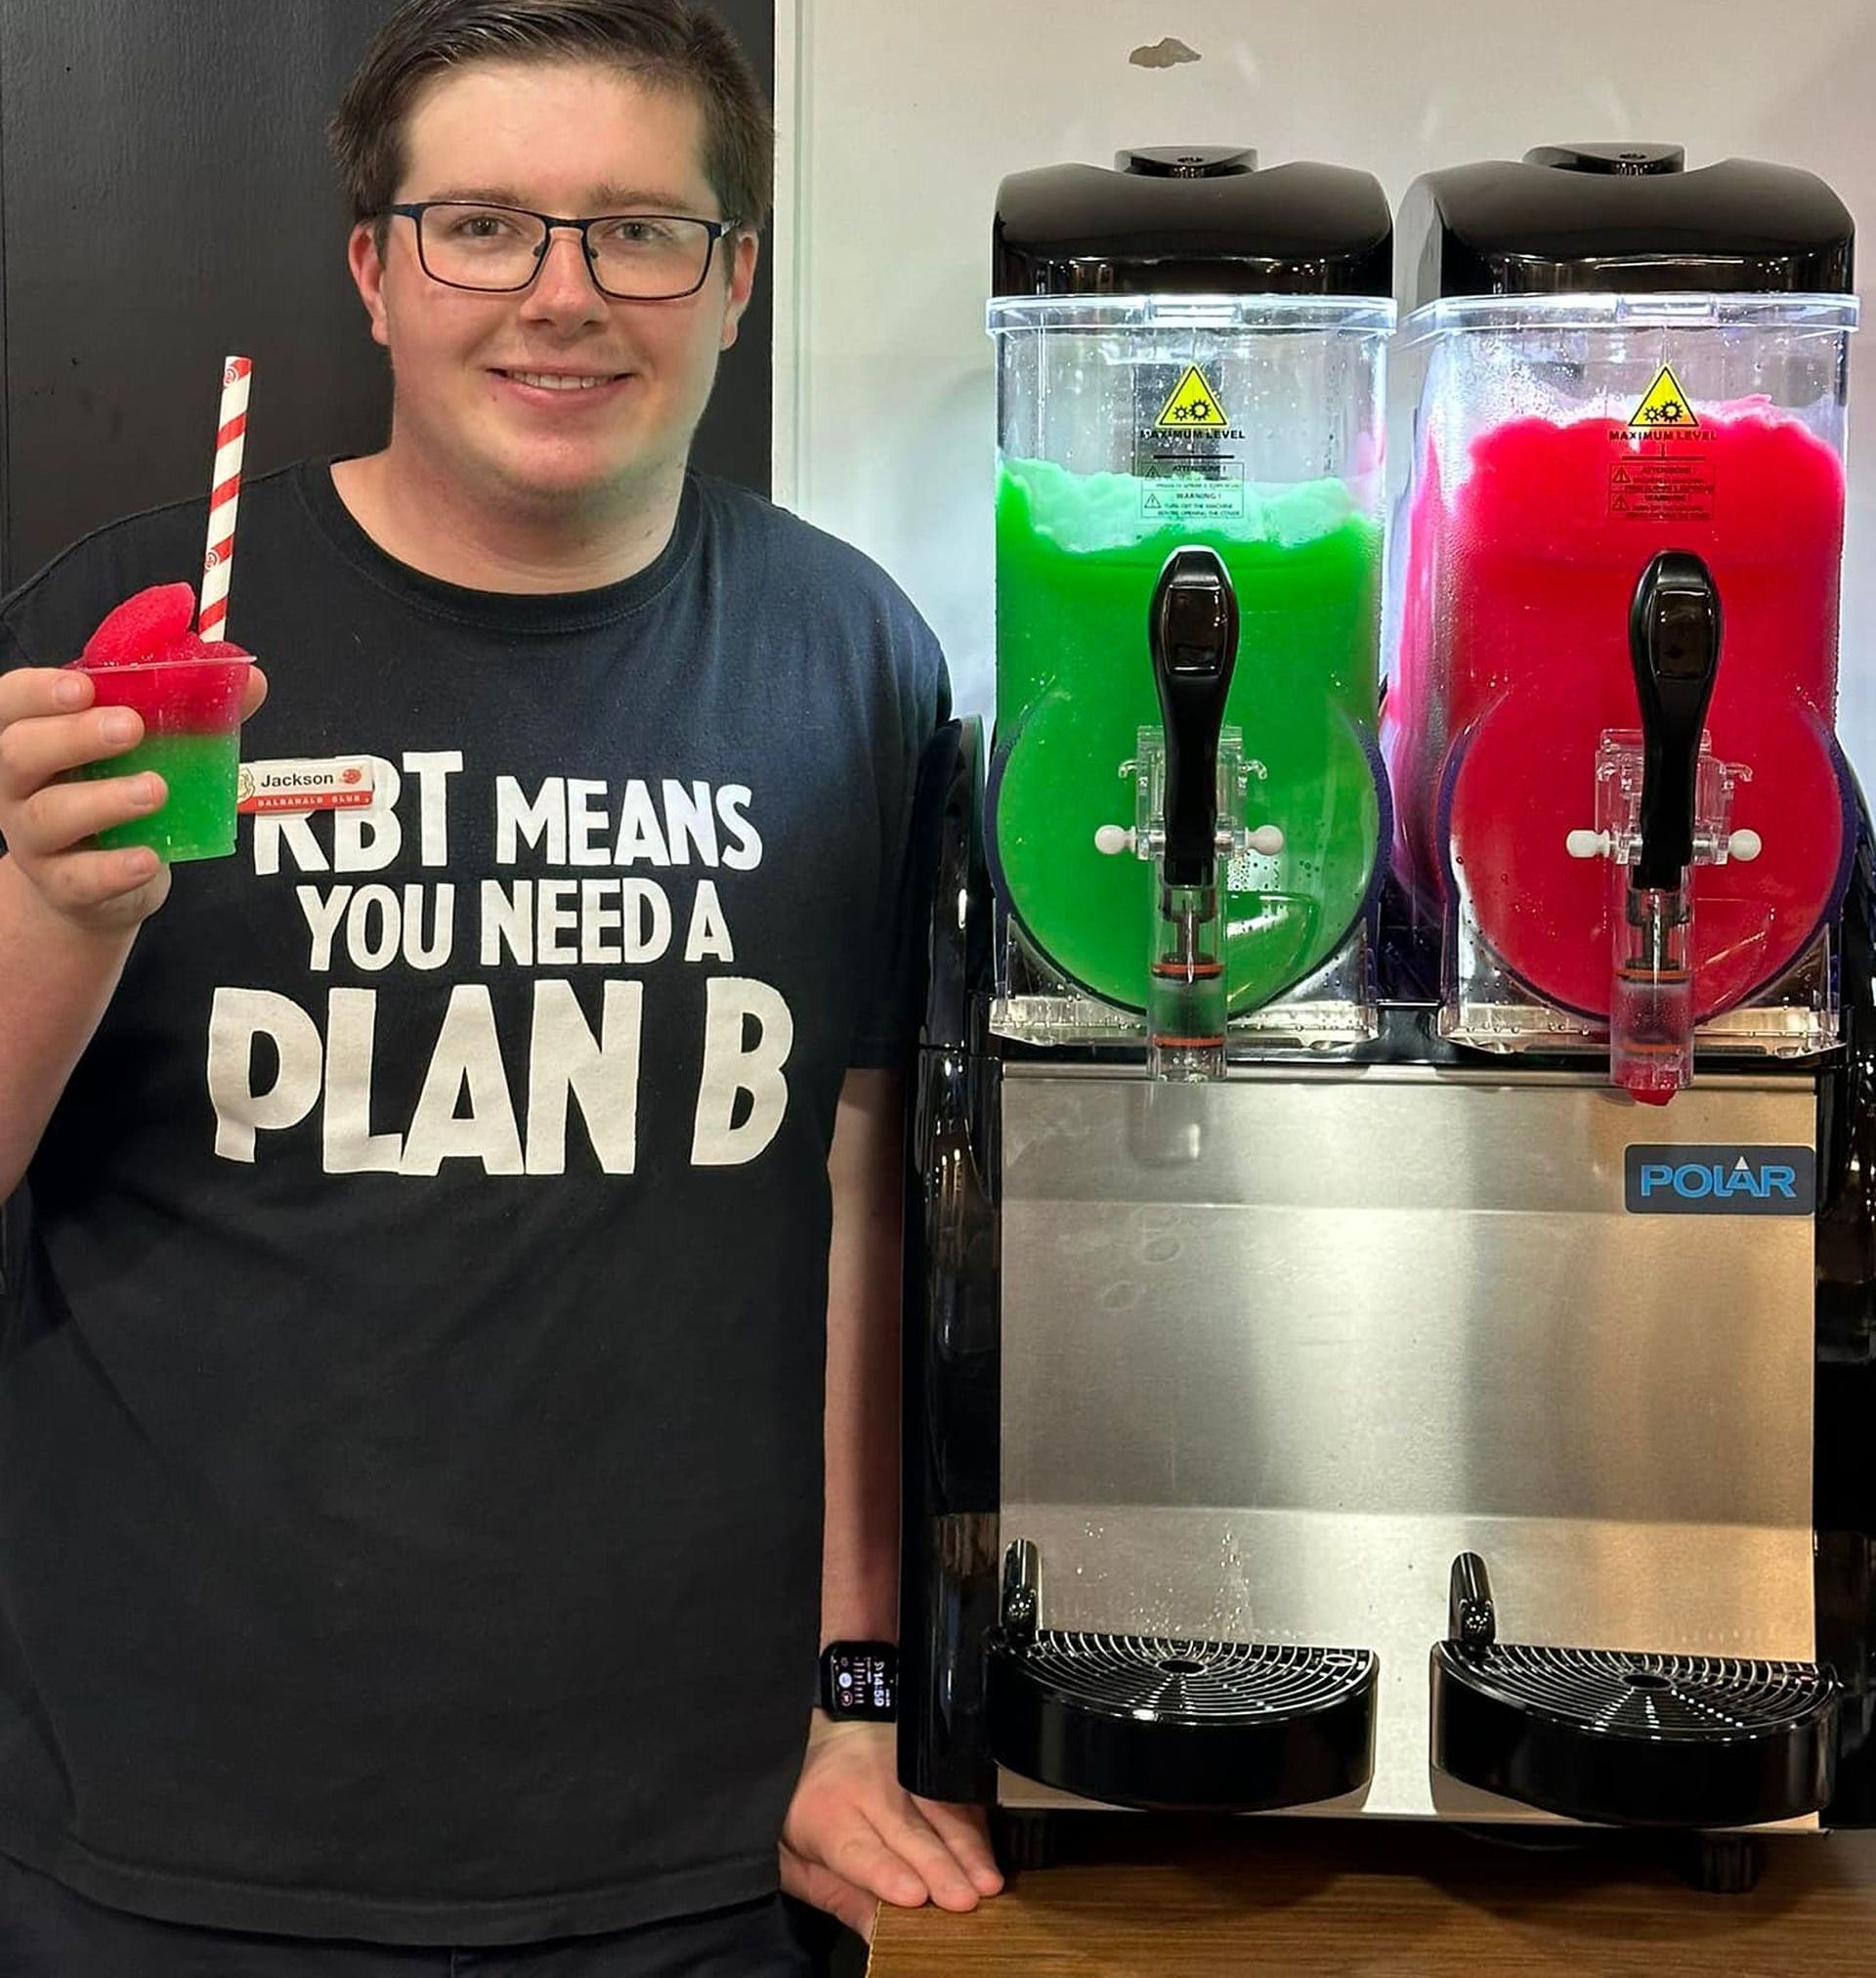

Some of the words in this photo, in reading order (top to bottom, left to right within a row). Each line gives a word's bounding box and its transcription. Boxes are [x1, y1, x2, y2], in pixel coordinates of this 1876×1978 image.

[1140, 429, 1204, 439] MAXIMUM
[1207, 429, 1246, 439] LEVEL
[1609, 431, 1674, 441] MAXIMUM
[1677, 431, 1717, 441] LEVEL
[261, 773, 333, 788] Jackson
[331, 795, 361, 803] CLUB
[495, 776, 762, 870] MEANS
[296, 883, 454, 970] YOU
[481, 878, 671, 966] NEED
[685, 882, 734, 962] A
[207, 978, 643, 1176] PLAN
[690, 977, 793, 1166] B
[1642, 1156, 1797, 1198] POLAR
[874, 1672, 885, 1706] 14:59
